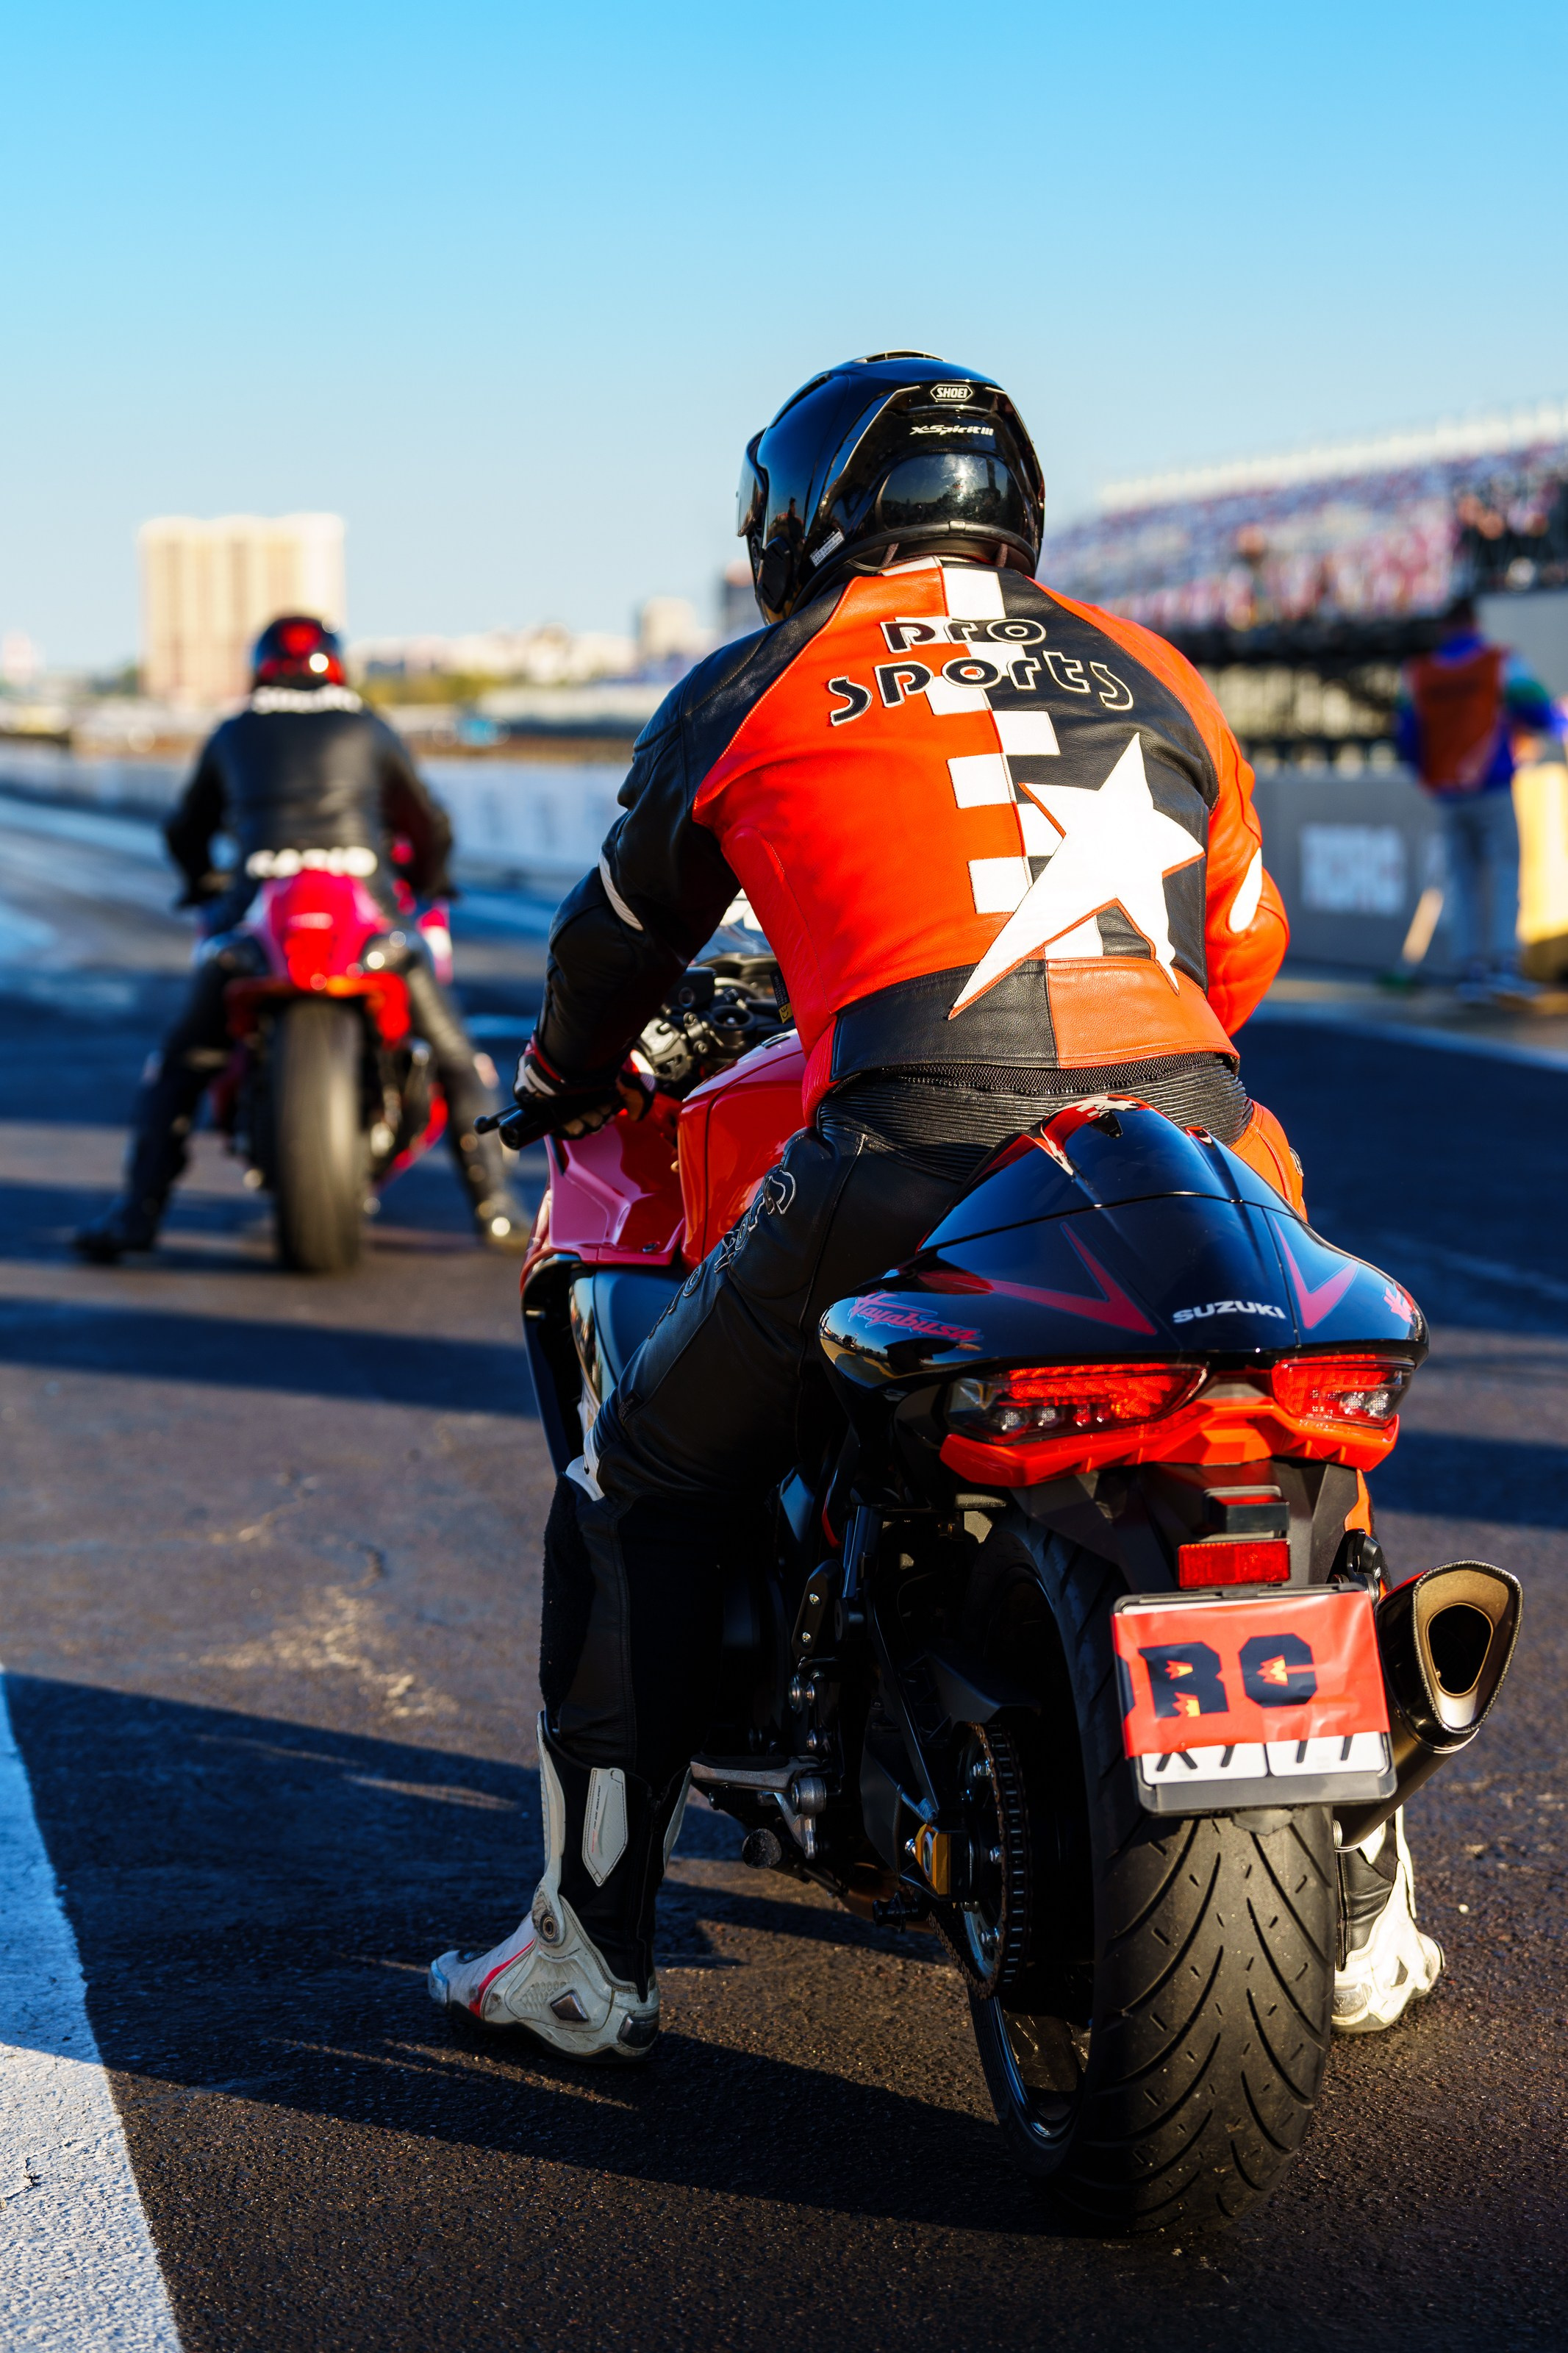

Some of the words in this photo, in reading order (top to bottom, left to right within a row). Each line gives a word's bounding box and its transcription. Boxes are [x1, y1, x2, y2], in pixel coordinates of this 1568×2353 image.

[936, 387, 968, 399] SHOEI
[781, 1005, 789, 1019] CE
[848, 1290, 984, 1341] Hayabusa
[1173, 1300, 1286, 1324] SUZUKI
[1115, 1632, 1318, 1718] RC
